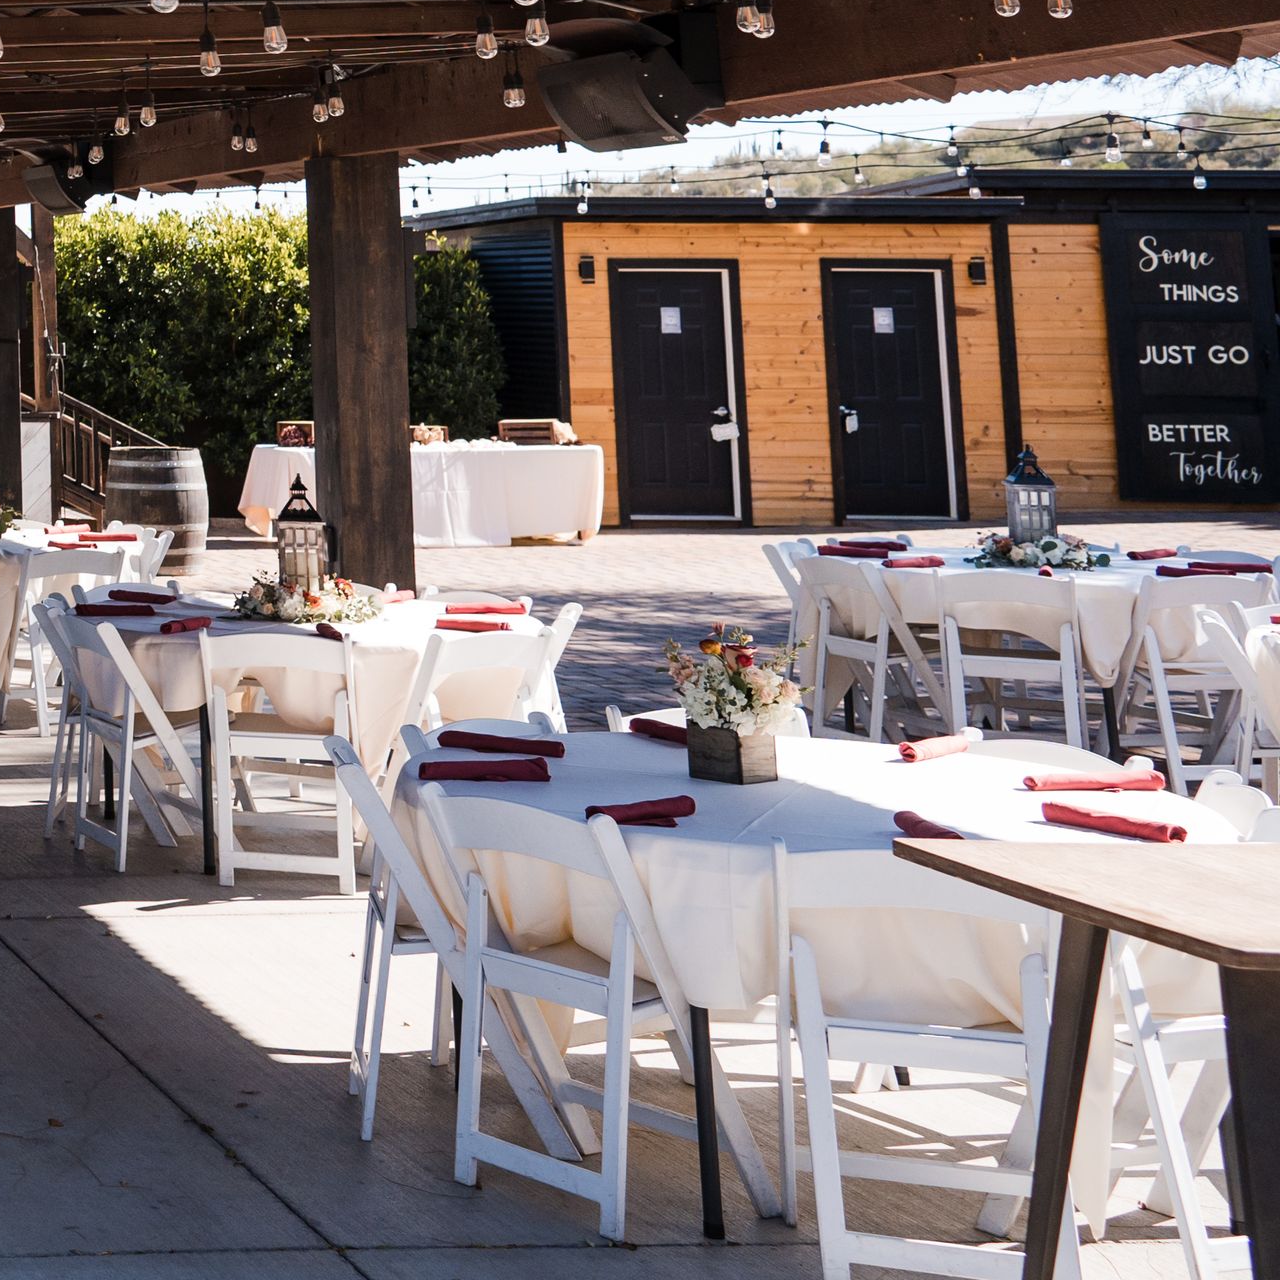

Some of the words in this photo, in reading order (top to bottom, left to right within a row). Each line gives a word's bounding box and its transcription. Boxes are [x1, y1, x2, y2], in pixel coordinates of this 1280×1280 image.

[1138, 235, 1215, 272] Some
[1159, 284, 1239, 303] THINGS
[1139, 345, 1197, 365] JUST
[1207, 345, 1250, 365] GO
[1147, 424, 1231, 443] BETTER
[1169, 451, 1263, 485] Together
